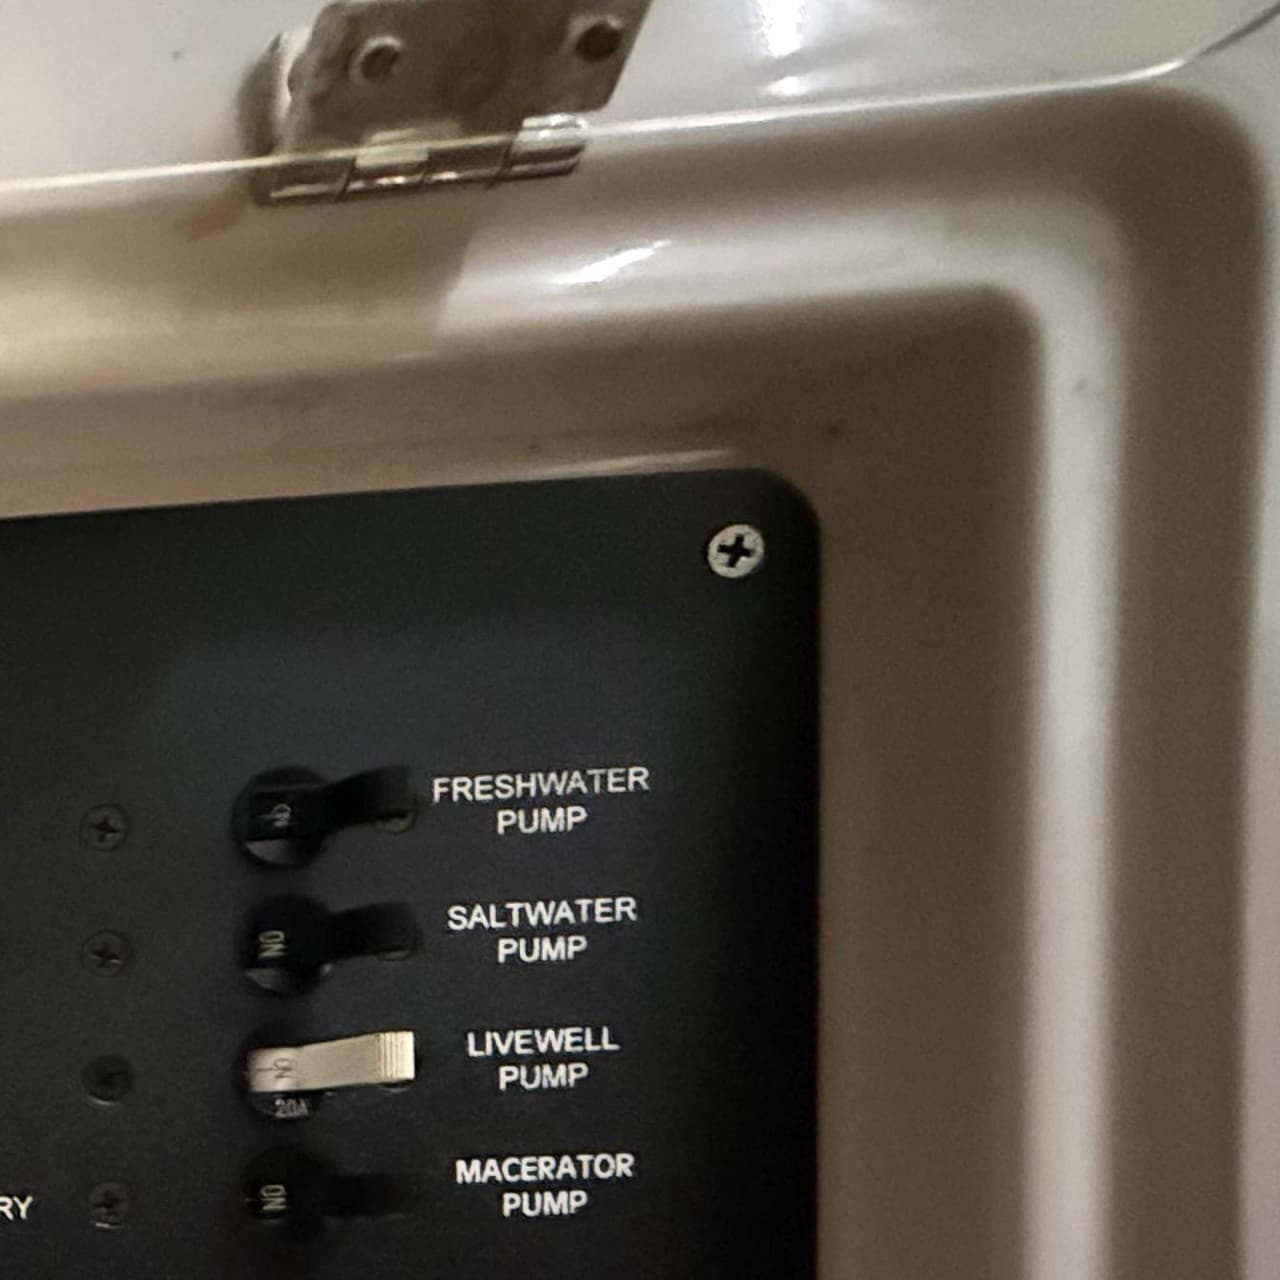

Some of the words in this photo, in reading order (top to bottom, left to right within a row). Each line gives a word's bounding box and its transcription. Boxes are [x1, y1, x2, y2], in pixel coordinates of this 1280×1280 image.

[432, 766, 650, 803] FRESHWATER
[496, 805, 589, 835] PUMP
[446, 896, 638, 931] SALTWATER
[257, 929, 287, 960] ON
[496, 934, 589, 964] PUMP
[466, 1026, 621, 1058] LIVEWELL
[497, 1062, 590, 1091] PUMP
[454, 1152, 636, 1185] MACERATOR
[259, 1184, 287, 1211] ON
[501, 1189, 589, 1218] PUMP
